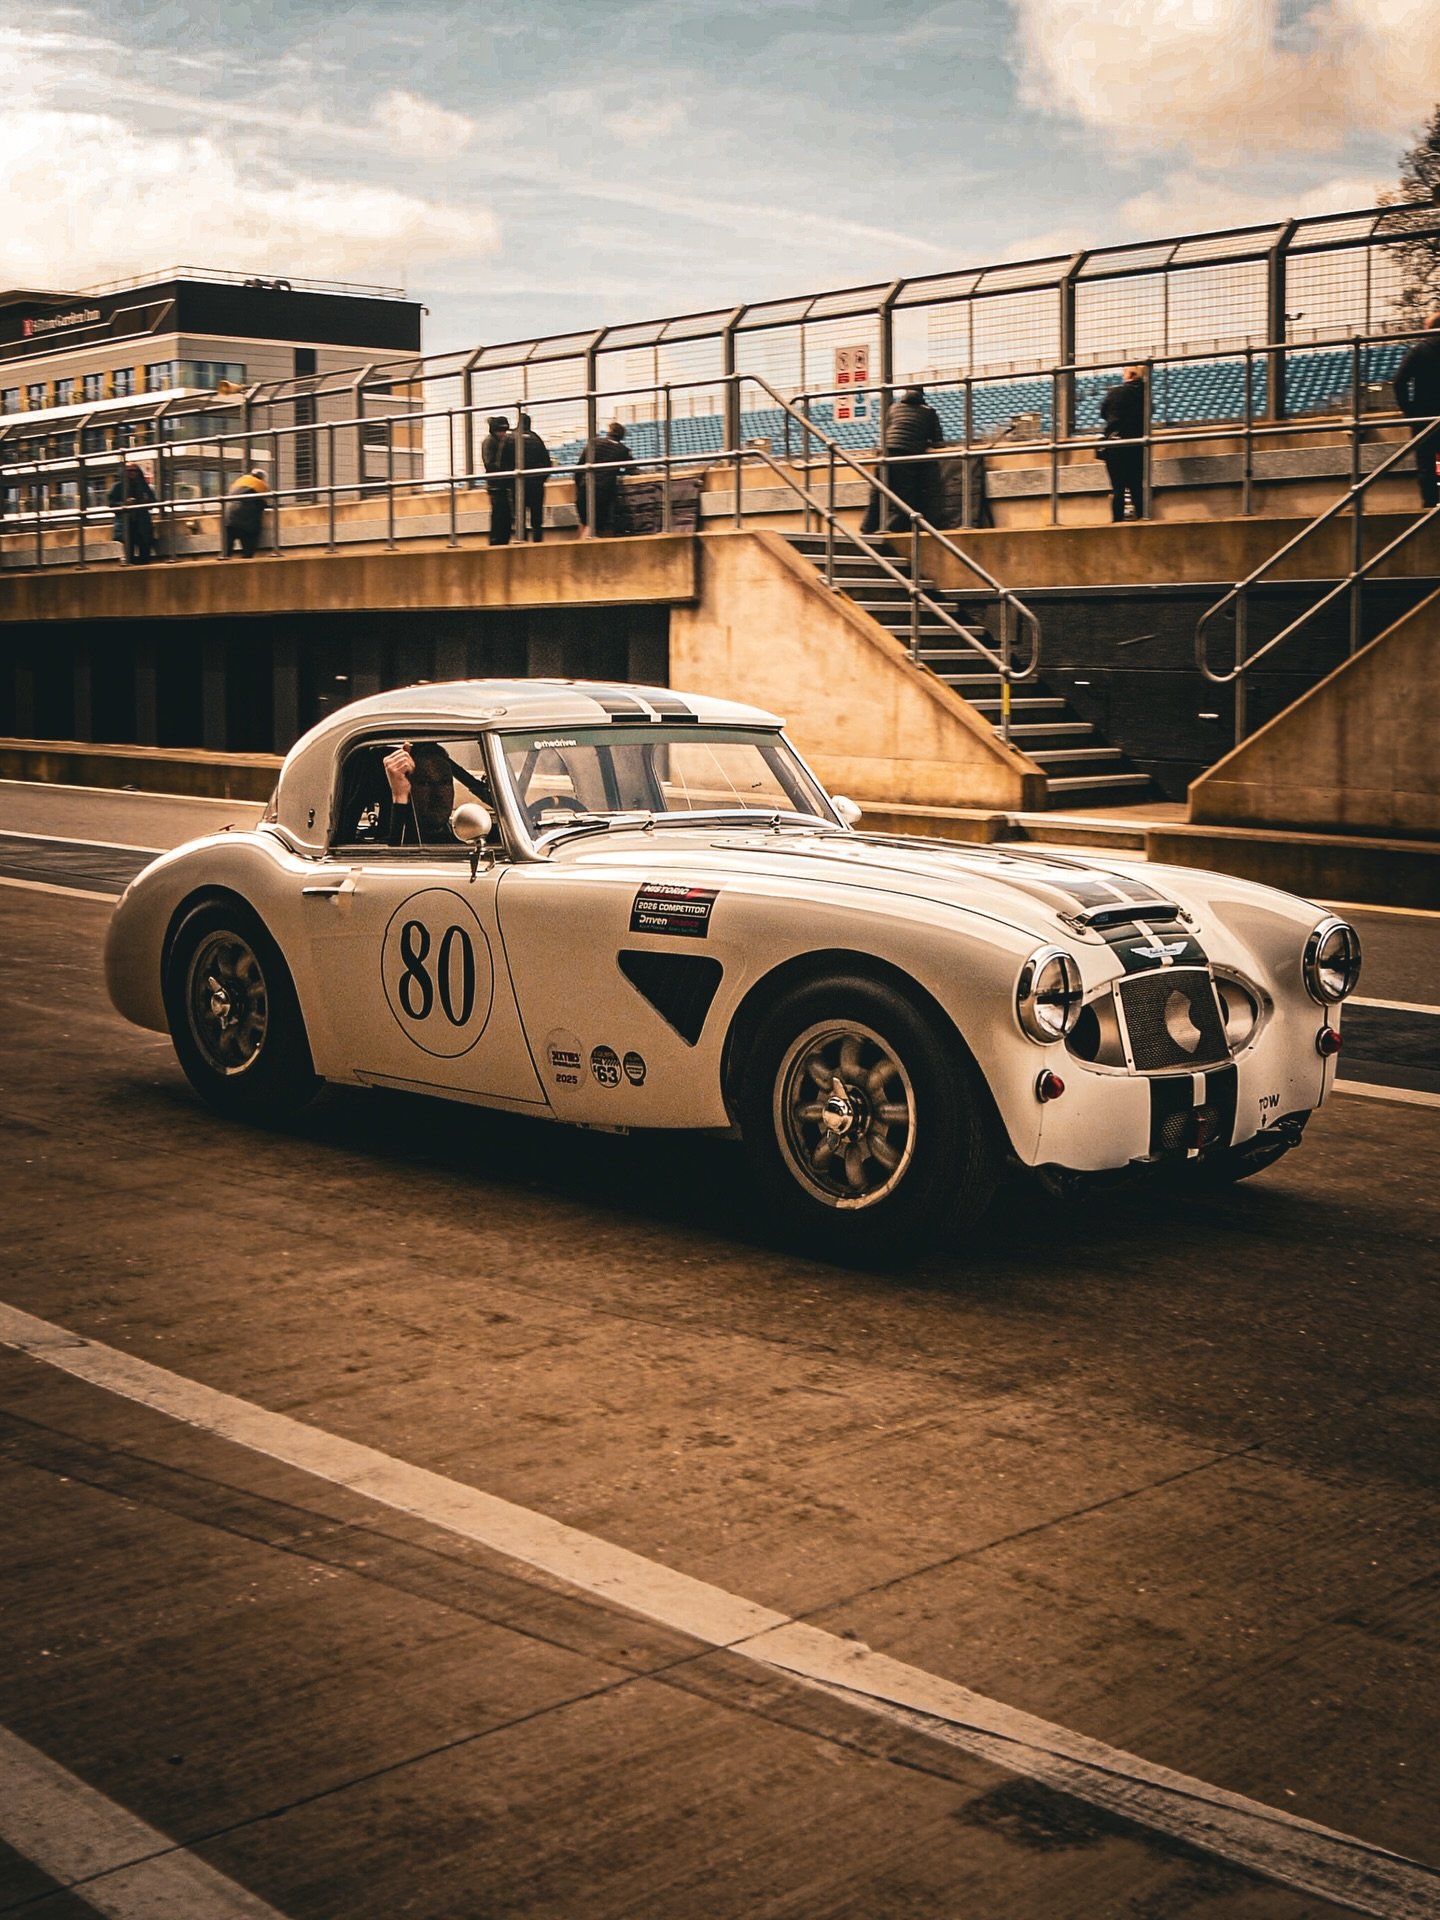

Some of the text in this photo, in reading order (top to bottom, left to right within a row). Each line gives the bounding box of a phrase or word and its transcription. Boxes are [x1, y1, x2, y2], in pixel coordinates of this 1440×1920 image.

[643, 885, 690, 895] HISTORIC
[638, 901, 706, 914] 2026 COMPETITOR
[639, 914, 668, 926] Driven
[399, 920, 475, 1026] 80
[556, 1073, 578, 1085] 2025
[1259, 1093, 1280, 1111] TOW
